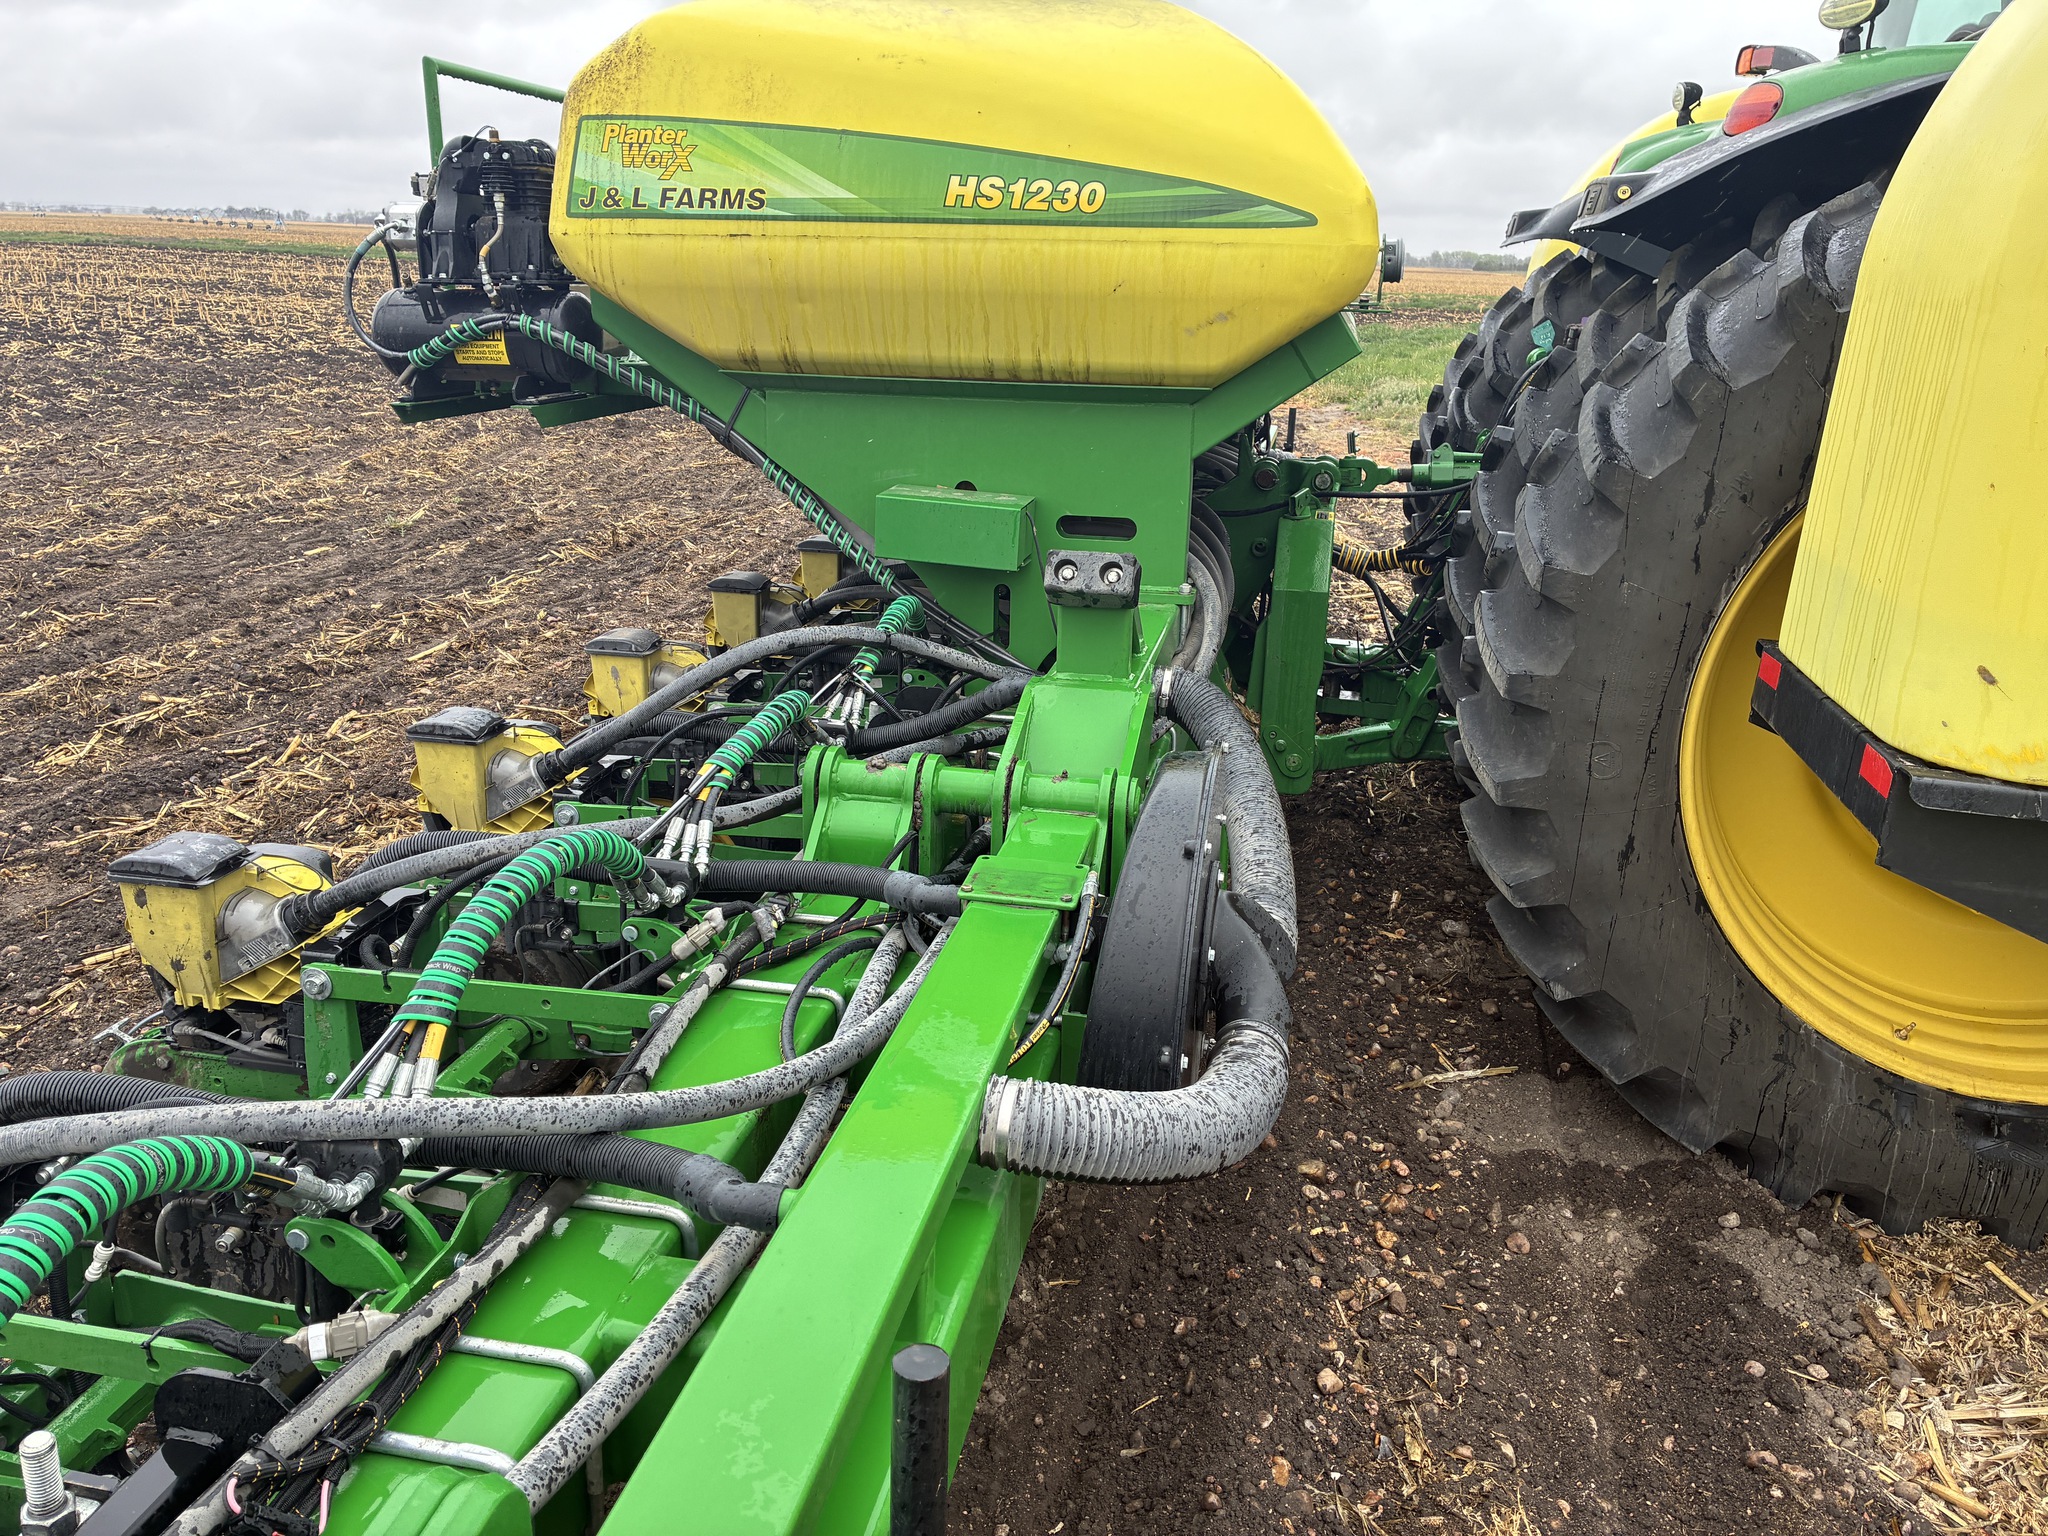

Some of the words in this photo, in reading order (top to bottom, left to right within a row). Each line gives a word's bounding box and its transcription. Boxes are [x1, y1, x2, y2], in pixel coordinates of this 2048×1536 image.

[601, 123, 688, 152] Planter
[621, 143, 698, 180] WorX
[579, 186, 597, 209] J
[602, 186, 624, 209] &
[631, 186, 648, 209] L
[658, 186, 767, 210] FARMS
[943, 174, 1107, 214] HS1230
[1635, 671, 1657, 743] TUBELESS
[1648, 773, 1657, 798] MAY
[1658, 660, 1675, 696] TUBE
[442, 961, 461, 974] Wrap
